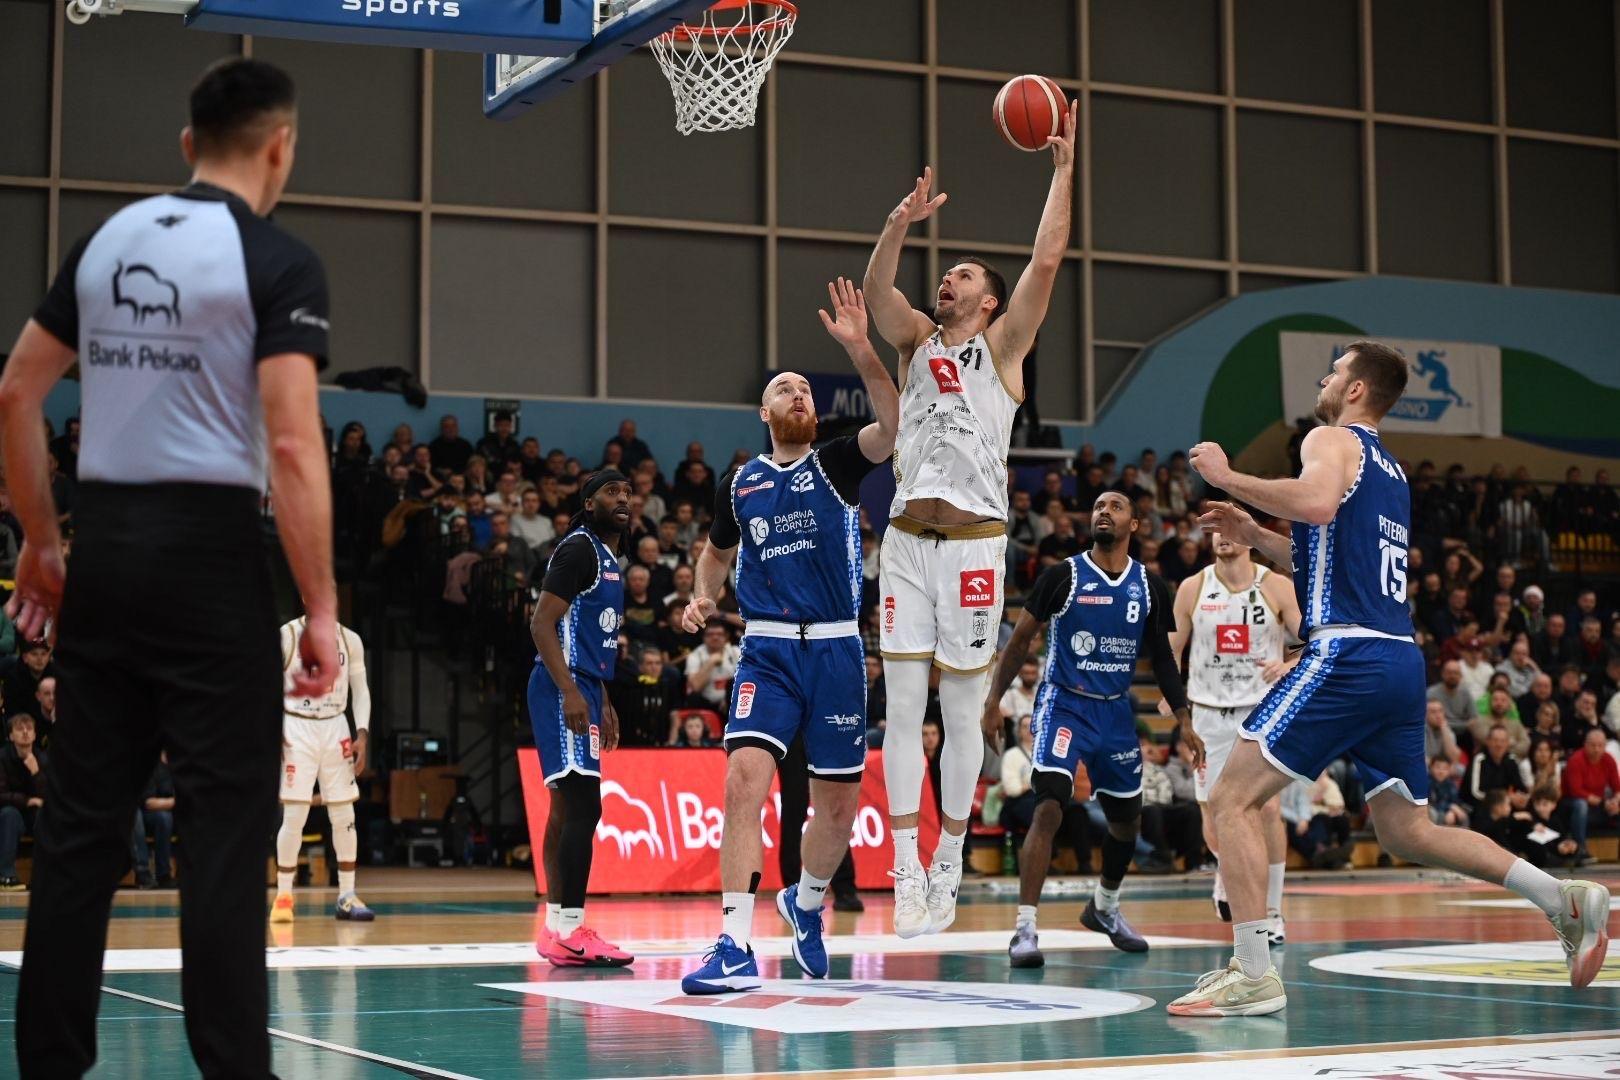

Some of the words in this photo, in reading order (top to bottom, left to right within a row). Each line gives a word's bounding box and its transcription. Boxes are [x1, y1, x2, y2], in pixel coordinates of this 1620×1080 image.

[88, 341, 132, 368] Bank
[138, 346, 201, 372] Pekao
[958, 347, 982, 370] 41
[1379, 538, 1408, 604] 15
[965, 593, 991, 602] ORLEN
[1126, 600, 1140, 623] 8
[1242, 605, 1265, 625] 12
[1086, 661, 1131, 672] DROGOPOL
